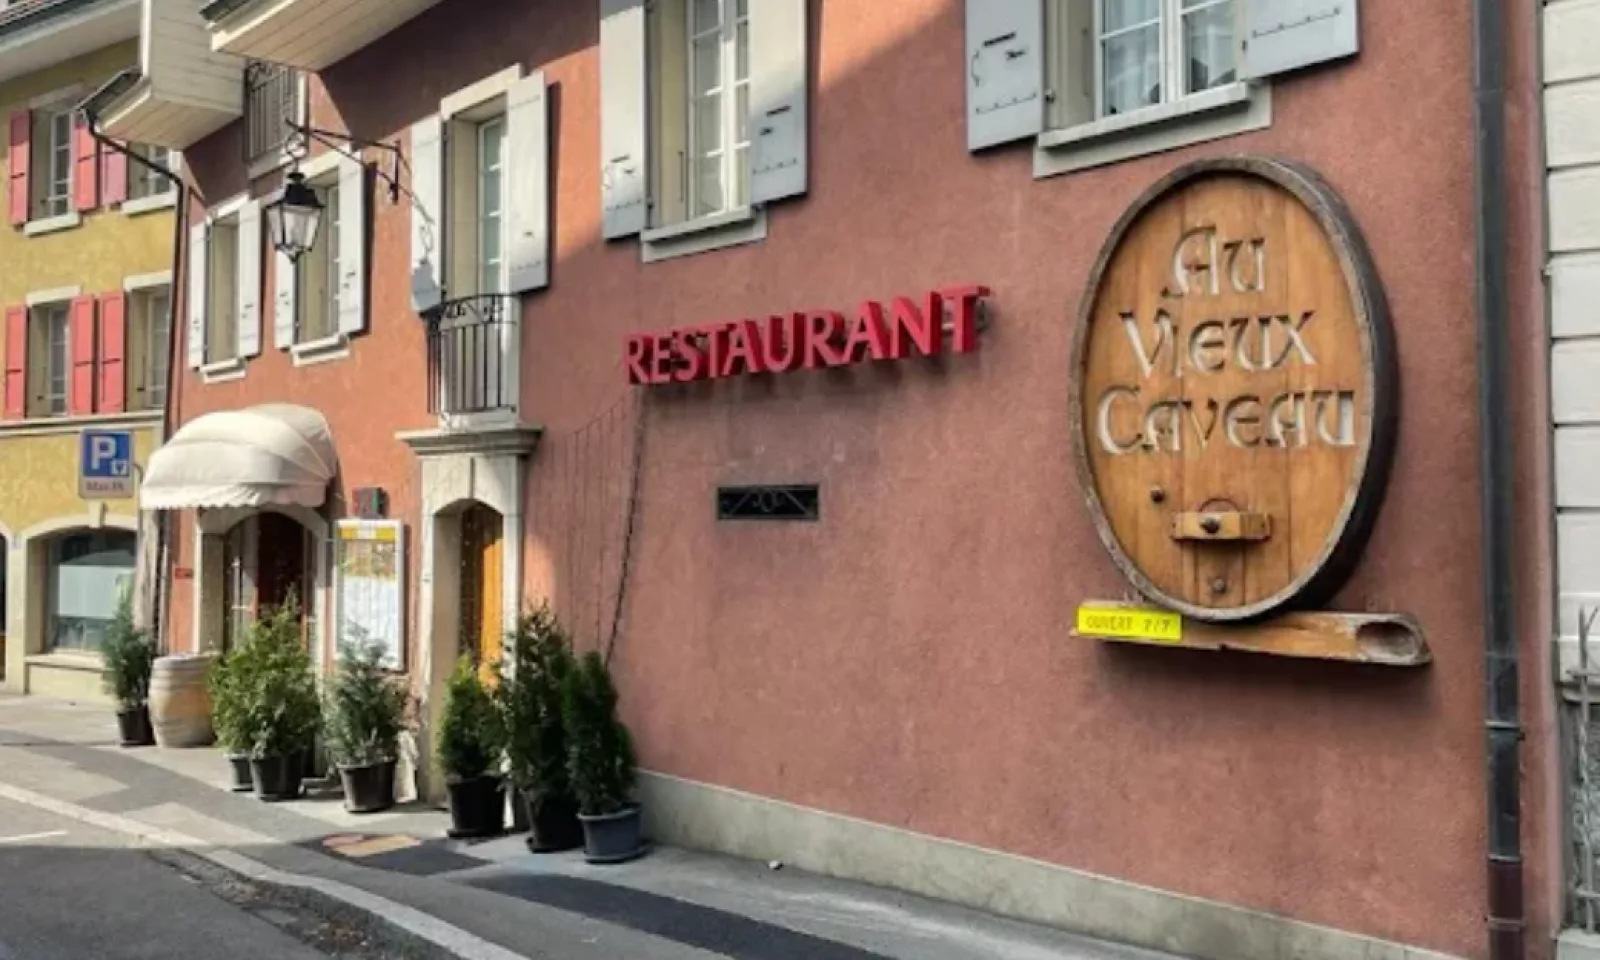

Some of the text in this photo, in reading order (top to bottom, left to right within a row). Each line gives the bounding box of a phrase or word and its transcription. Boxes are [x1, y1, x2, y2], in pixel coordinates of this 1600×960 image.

[622, 285, 991, 386] RESTAURANT
[1097, 384, 1358, 456] CAVEAU
[91, 435, 117, 471] P
[1086, 615, 1172, 633] OUVERT 7/7
